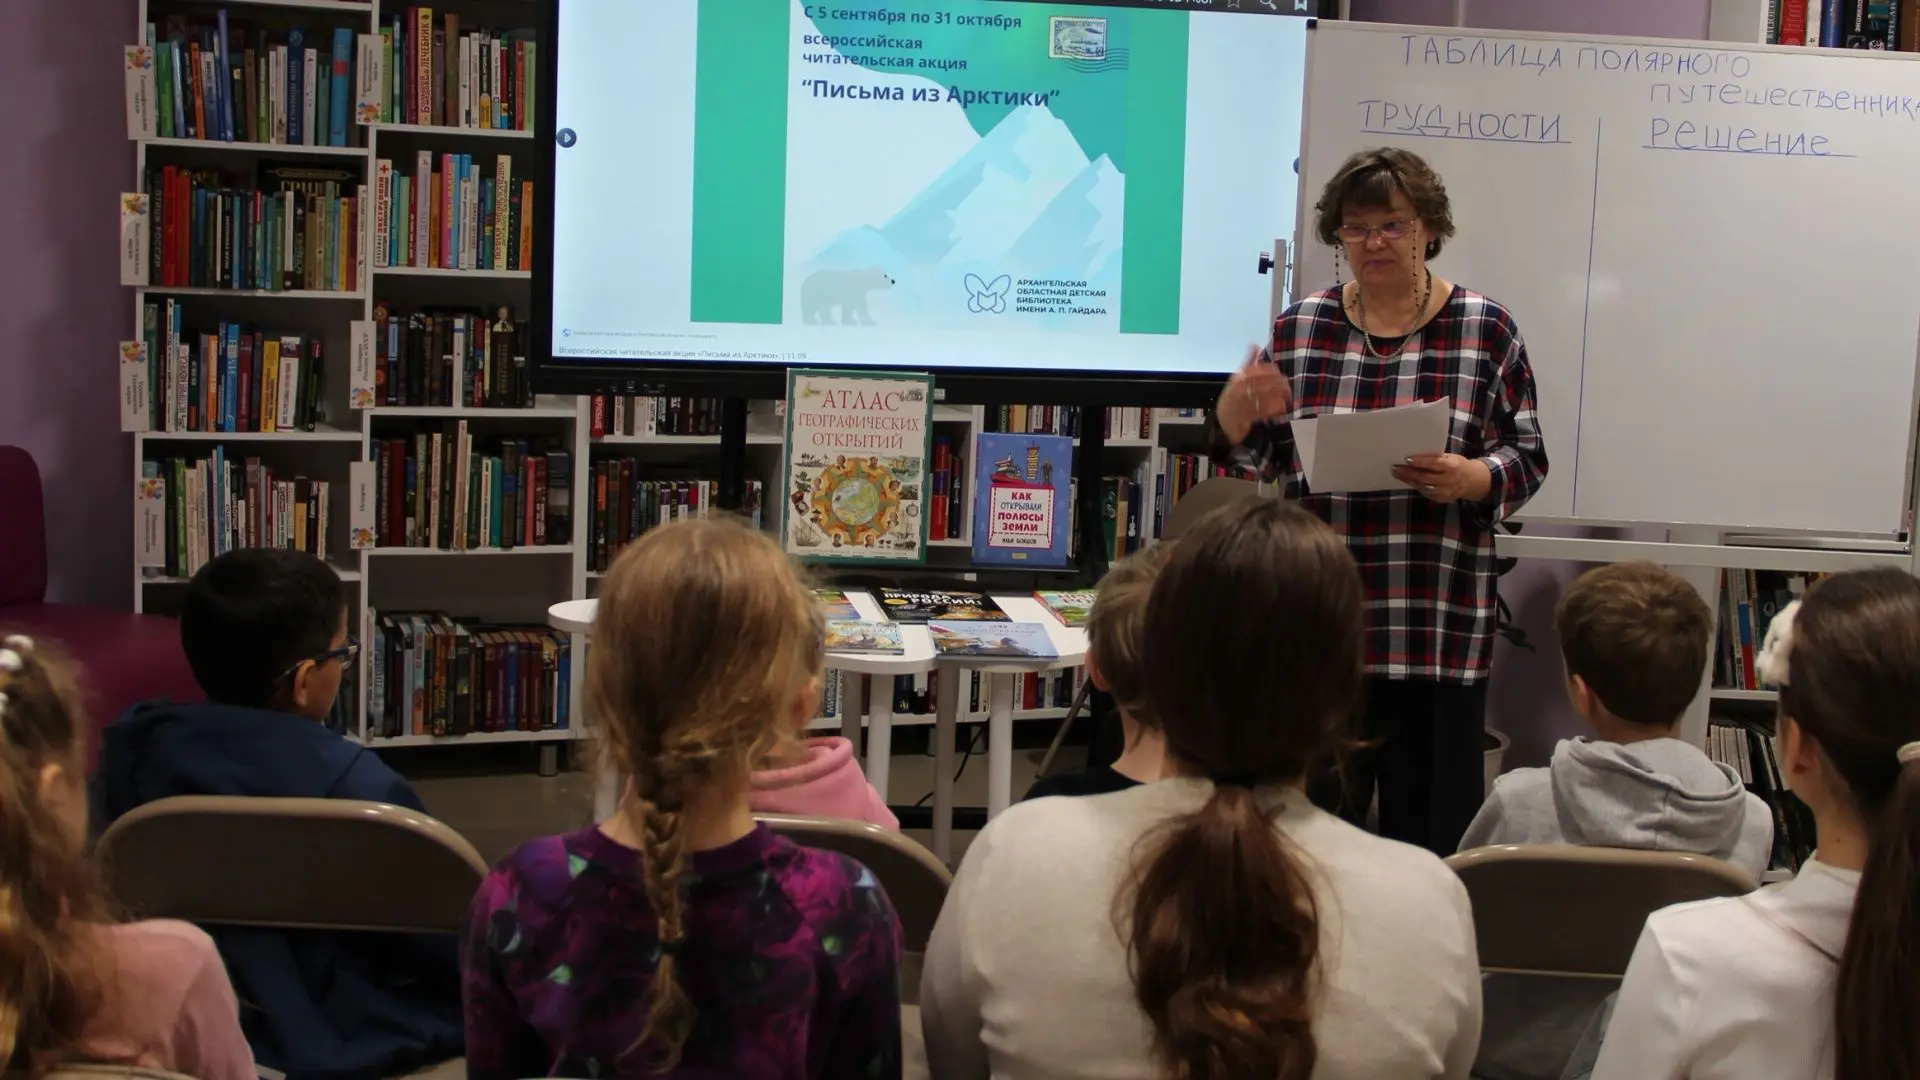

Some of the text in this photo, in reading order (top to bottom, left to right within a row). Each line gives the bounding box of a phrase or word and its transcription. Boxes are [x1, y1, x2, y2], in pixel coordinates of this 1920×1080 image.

[804, 6, 1022, 30] С 5 сентября по 31 октября
[803, 34, 923, 49] всероссийская
[802, 53, 968, 71] читательская акция
[1401, 35, 1751, 78] ТАБЛИЦА ПОЛЯРНОГО
[912, 88, 940, 102] из
[1356, 100, 1562, 142] ТРУДНОСТИ
[1017, 279, 1087, 288] АРХАНГЕЛЬСКАЯ
[1016, 288, 1106, 297] ОБЛАСТНАЯ ДЕТСКАЯ
[1068, 307, 1107, 315] ГАЙДАРА
[822, 389, 901, 411] АТЛАС
[798, 413, 920, 431] ГЕОГРАФИЧЕСКИХ
[812, 432, 903, 449] ОТКРЫТИЙ
[1011, 492, 1032, 500] КАК
[1000, 502, 1042, 511] ОТКРЫВАЛИ
[998, 512, 1044, 522] ПОЛЮСЫ
[883, 592, 951, 600] ПРИРОДА
